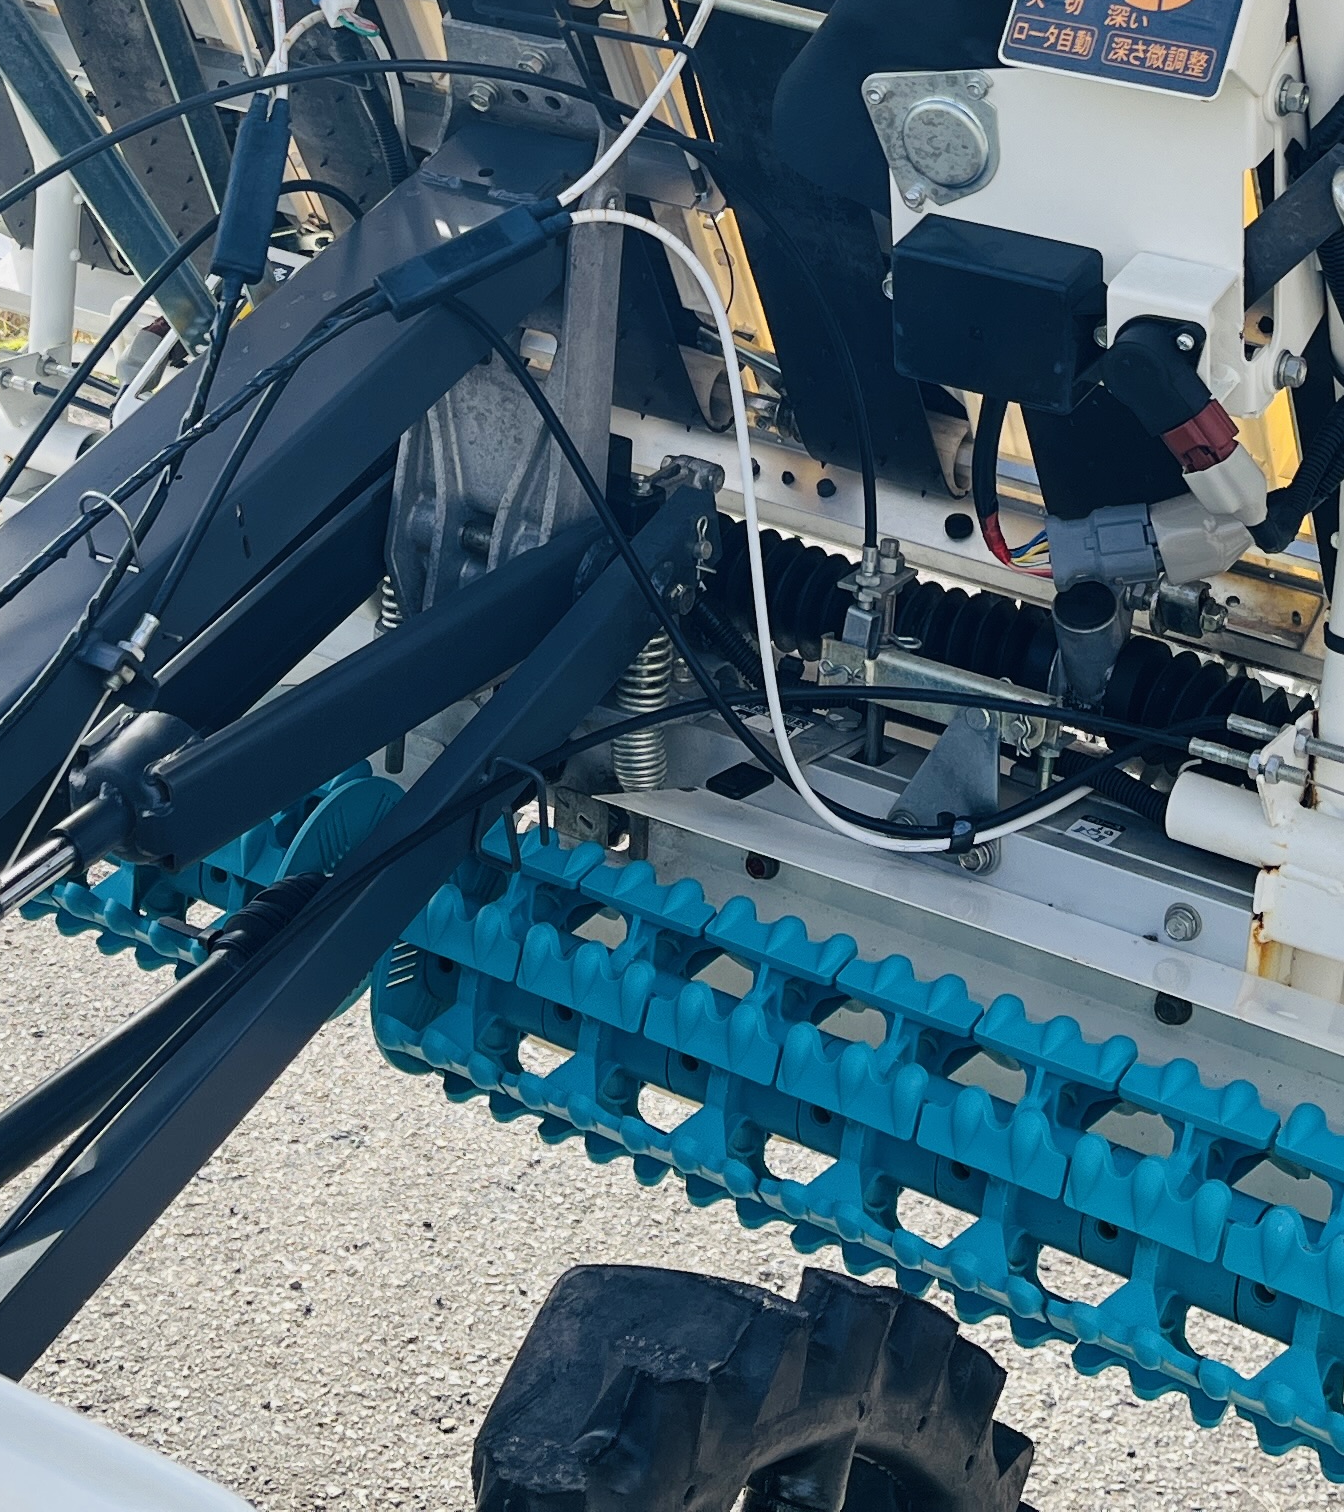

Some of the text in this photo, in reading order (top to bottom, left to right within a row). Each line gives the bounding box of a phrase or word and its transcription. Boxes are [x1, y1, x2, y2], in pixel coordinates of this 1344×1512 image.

[1104, 4, 1149, 29] 深い
[1013, 21, 1093, 55] ロータ自動
[1108, 36, 1209, 78] 深さ微調整
